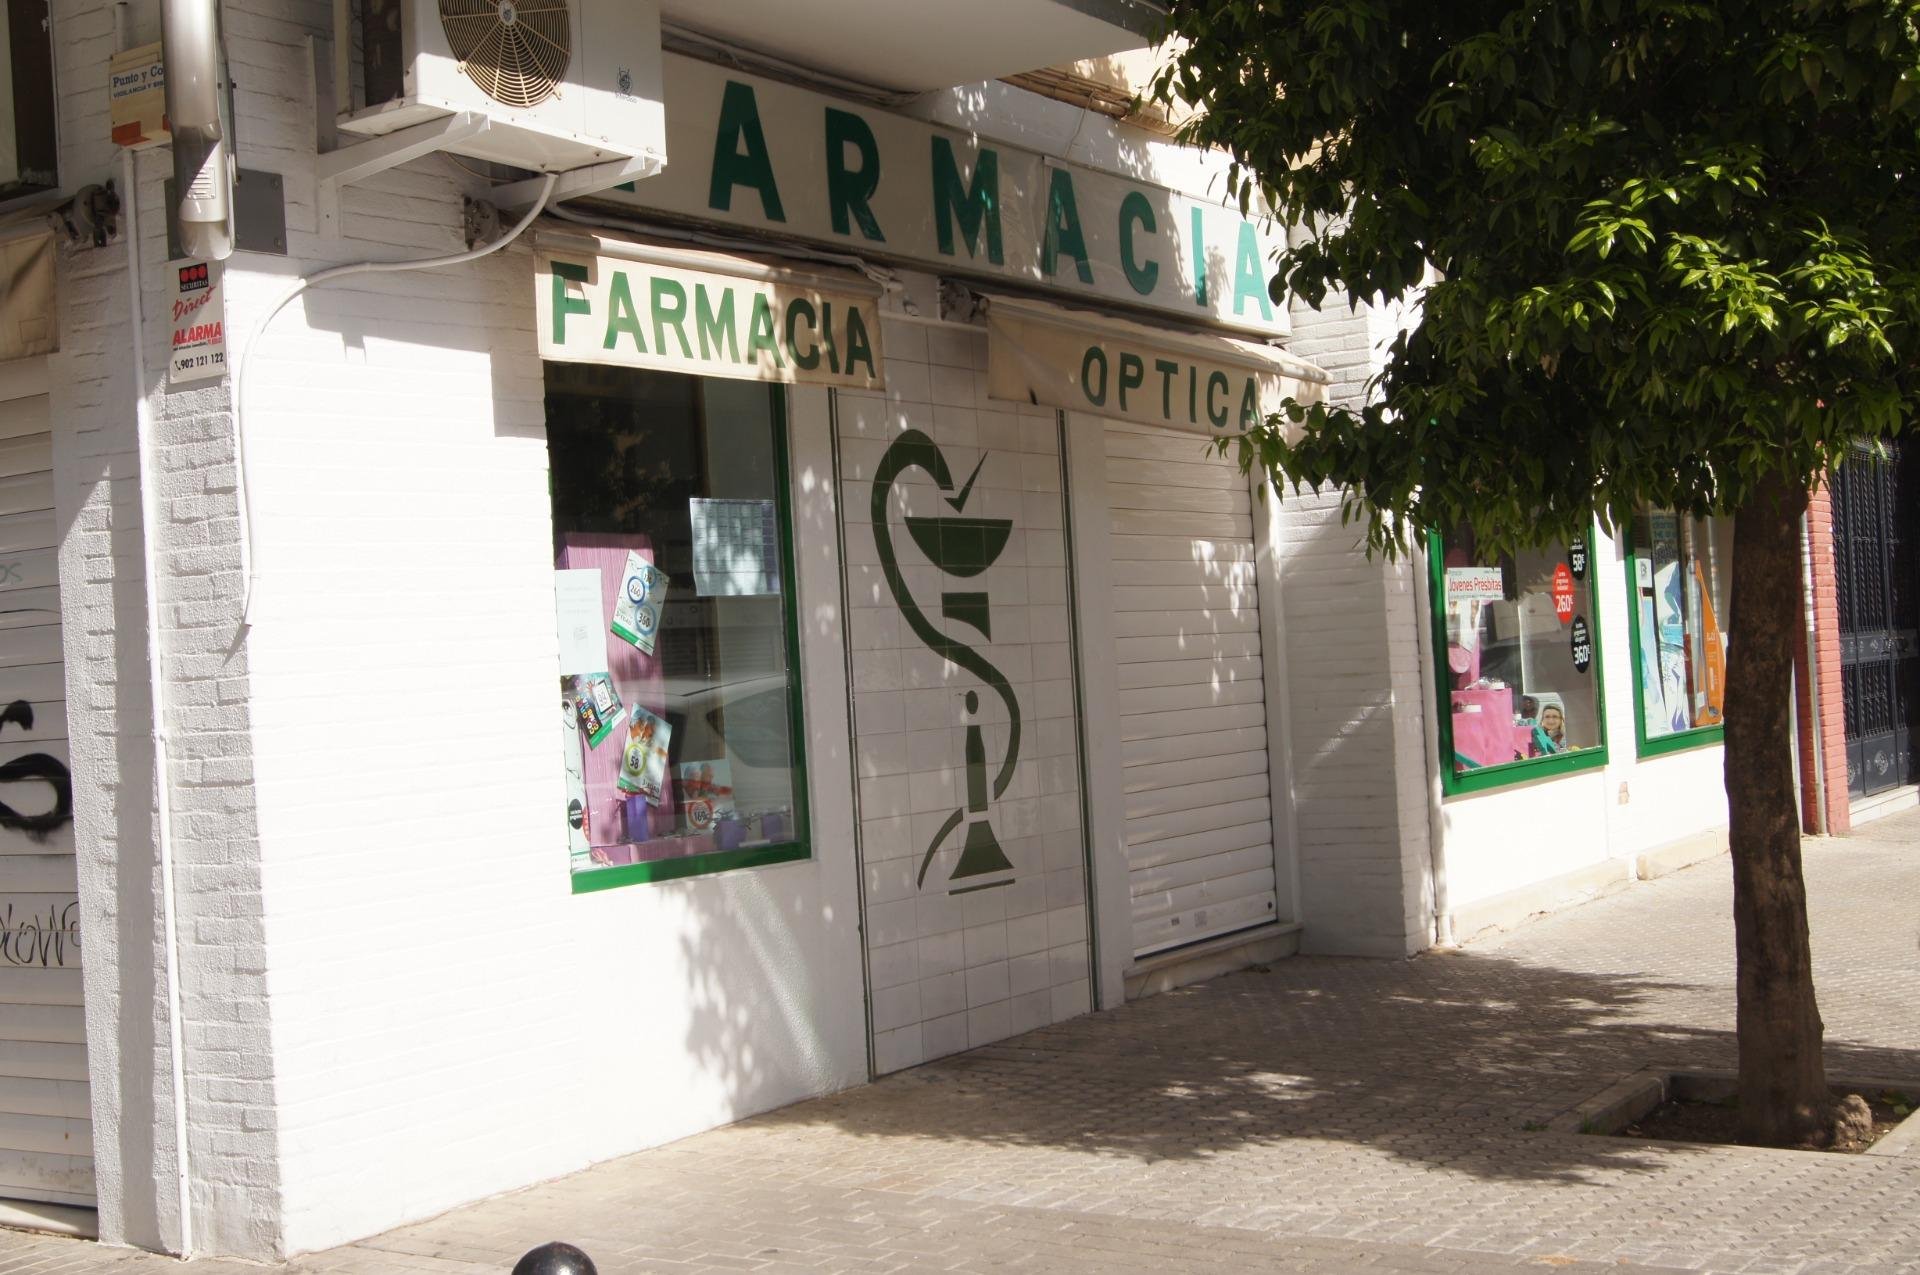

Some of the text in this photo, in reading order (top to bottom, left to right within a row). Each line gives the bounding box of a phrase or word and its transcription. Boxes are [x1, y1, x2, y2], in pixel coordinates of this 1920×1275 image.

[113, 73, 139, 88] Punto
[141, 71, 147, 83] y
[614, 80, 1273, 321] ARMACIA
[181, 280, 209, 291] SECURITAS
[172, 285, 215, 321] Direct
[172, 321, 222, 346] ALARMA
[550, 260, 876, 378] FARMACIA
[180, 352, 224, 369] 902 121 122
[1081, 346, 1260, 431] OPTICA
